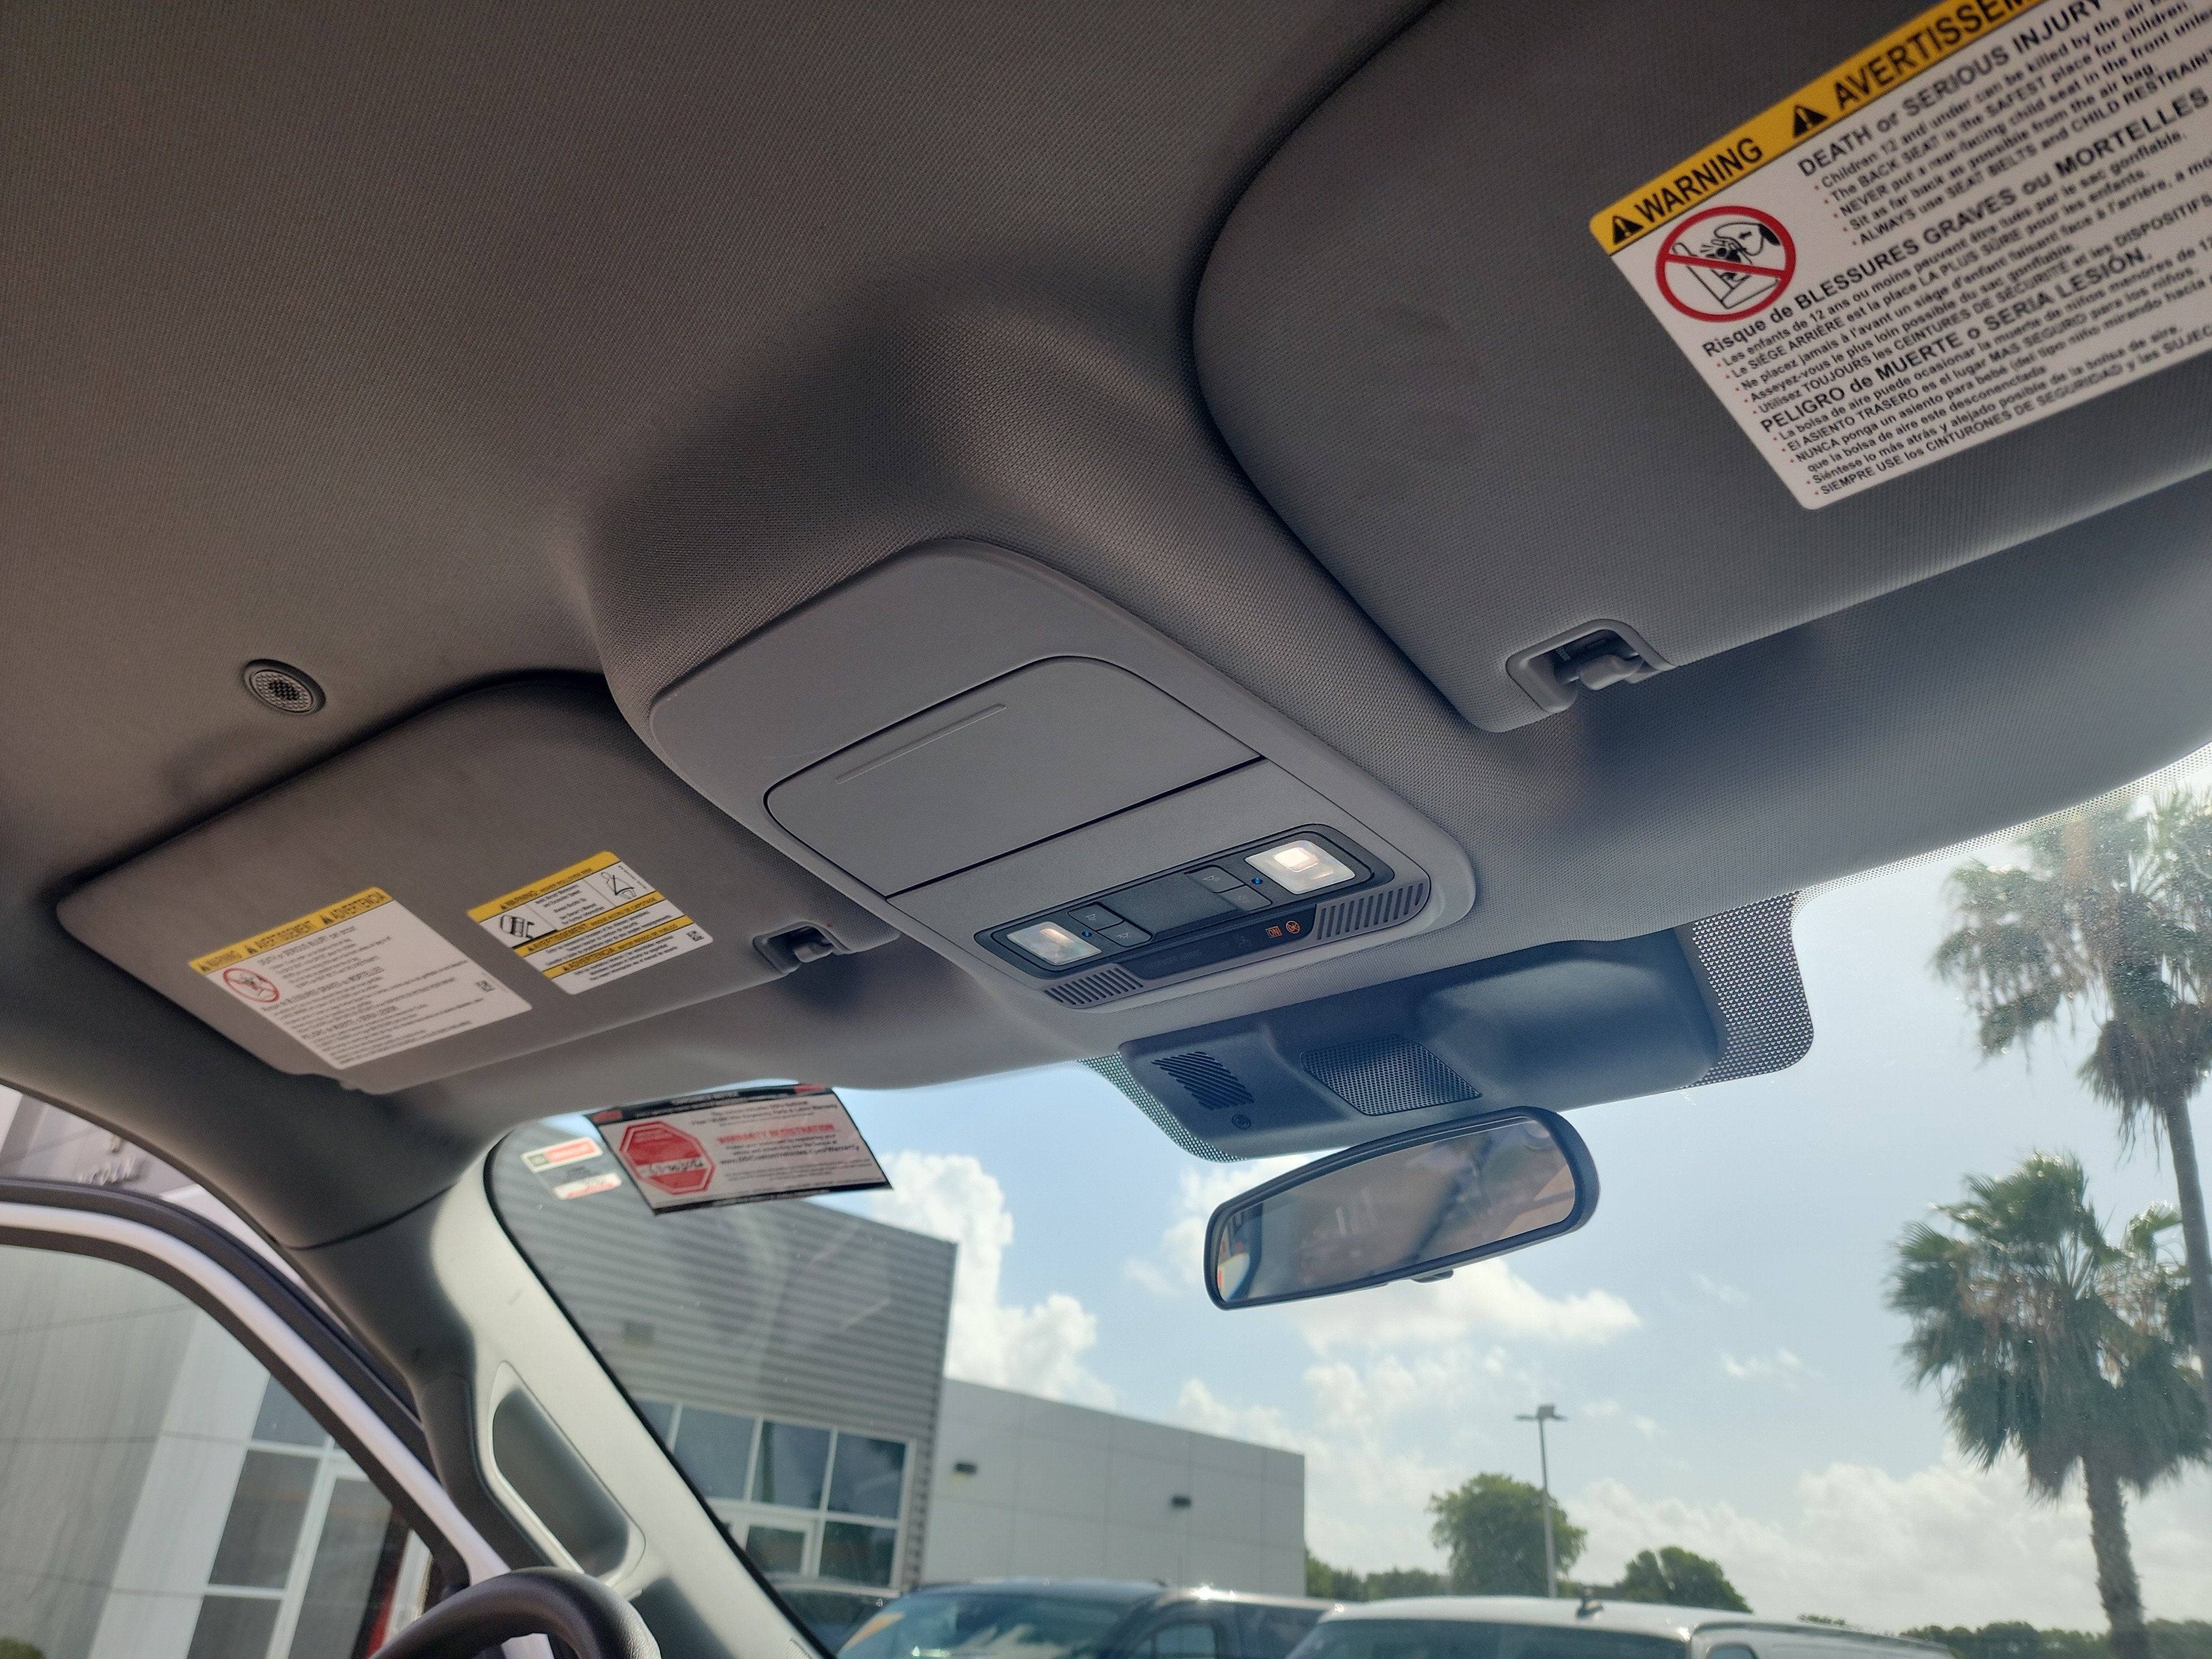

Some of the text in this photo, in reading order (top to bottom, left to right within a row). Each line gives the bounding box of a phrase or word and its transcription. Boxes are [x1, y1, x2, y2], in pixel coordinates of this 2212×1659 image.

[1634, 0, 2024, 223] WARNING AVERTISSE
[1797, 0, 2101, 176] DEATH or SERIOUS INJURY
[1820, 152, 1878, 188] Children
[2070, 33, 2091, 49] by
[2093, 16, 2120, 36] the
[1829, 184, 1858, 201] The
[1857, 158, 1899, 187] BACK
[2051, 54, 2092, 85] place
[2094, 40, 2117, 57] for
[1839, 184, 1889, 216] NEVER
[2048, 79, 2081, 104] seat
[2083, 71, 2100, 85] in
[2101, 56, 2128, 75] the
[2130, 30, 2170, 59] front
[1849, 214, 1870, 231] Sit
[2069, 95, 2095, 113] the
[1860, 208, 1916, 244] ALWAYS
[2070, 100, 2120, 132] CHILD
[1701, 87, 2212, 357] Risque de BLESSURES GRAVES ou MORTELLES
[1721, 351, 1746, 367] Les
[1746, 328, 1791, 354] enfants
[1792, 320, 1808, 332] de
[1809, 309, 1825, 322] 12
[1827, 298, 1851, 315] ans
[1851, 289, 1870, 302] ou
[1870, 268, 1912, 293] moins
[1730, 249, 1979, 378] Le SIÈGE ARRIÈRE est la place LA PLUS
[1740, 378, 1759, 390] Ne
[1759, 358, 1799, 384] placez
[1797, 339, 1839, 366] jamais
[1849, 312, 1893, 338] l'avant
[1893, 304, 1912, 317] un
[1750, 359, 1831, 403] Asseyez-vous
[1830, 353, 1844, 364] le
[1845, 340, 1874, 359] plus
[1873, 327, 1900, 343] loin
[1901, 300, 1957, 333] possible
[1759, 246, 2152, 433] PELIGRO de MUERTE o SERIA LESIÓN.
[1801, 354, 1872, 392] TOUJOURS
[1871, 347, 1893, 361] les
[1893, 308, 1971, 350] CEINTURES
[1971, 296, 1994, 314] DE
[1778, 429, 1796, 440] La
[1794, 414, 1830, 433] bolsa
[1830, 406, 1846, 418] de
[1848, 395, 1871, 410] aire
[1872, 377, 1911, 401] puede
[1913, 347, 1975, 380] ocasionar
[1786, 439, 1802, 451] El
[1802, 415, 1855, 446] ASIENTO
[1856, 387, 1919, 420] TRASERO
[1921, 381, 1938, 393] es
[1938, 372, 1952, 385] el
[1952, 358, 1986, 379] lugar
[1794, 380, 1974, 462] NUNCA ponga un asiento para
[1812, 459, 1863, 484] Siéntese
[1862, 453, 1877, 462] lo
[1877, 441, 1905, 457] más
[1906, 427, 1938, 445] atrás
[1939, 422, 1948, 434] y
[1950, 403, 1996, 427] alejado
[1807, 458, 1829, 473] que
[1828, 453, 1843, 462] la
[1841, 439, 1877, 457] bolsa
[1877, 431, 1893, 442] de
[1895, 420, 1918, 435] aire
[1820, 400, 2034, 494] SIEMPRE USE los CINTURONES DE
[1268, 927, 1280, 936] ON
